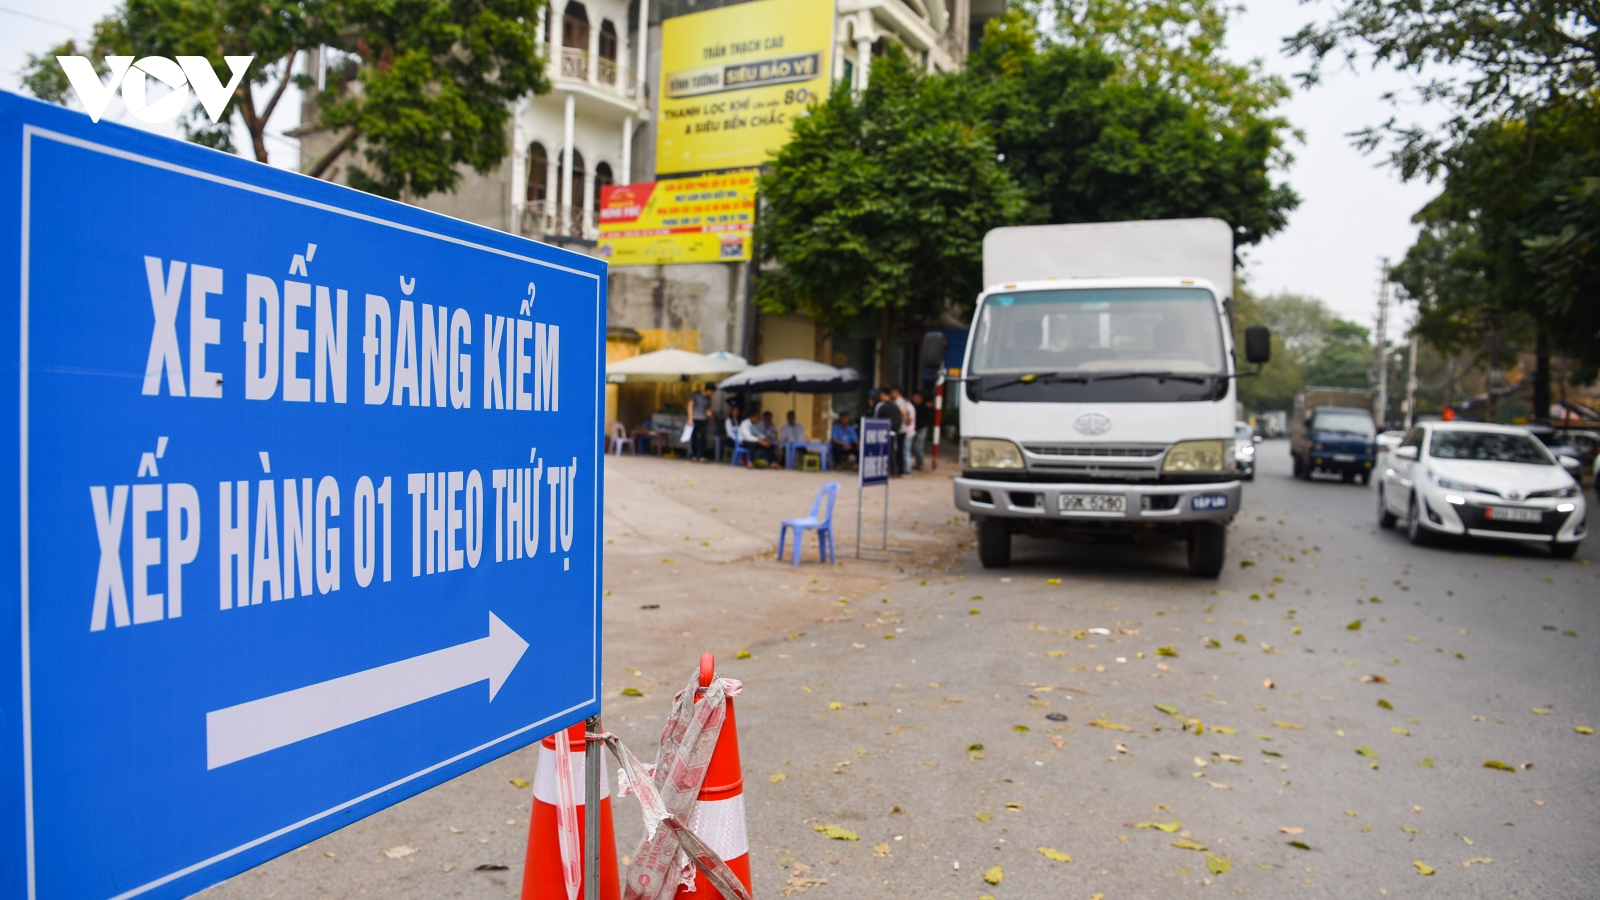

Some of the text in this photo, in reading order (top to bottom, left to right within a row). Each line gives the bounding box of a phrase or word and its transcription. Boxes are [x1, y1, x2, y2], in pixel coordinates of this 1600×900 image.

[730, 40, 761, 57] THẠCH
[765, 36, 784, 50] CAO
[726, 65, 758, 84] SIÊU
[759, 59, 791, 80] BẢO
[794, 56, 815, 76] VỆ
[665, 106, 700, 120] THANH
[703, 102, 726, 116] LỌC
[730, 95, 751, 111] KHÍ
[685, 123, 692, 135] &
[695, 119, 720, 134] SIÊU
[750, 109, 786, 128] CHẮC
[141, 243, 560, 412] XE ĐẾN ĐĂNG KIỂM
[90, 436, 578, 632] XẾP HÀNG 01 THEO THỨ TỰ
